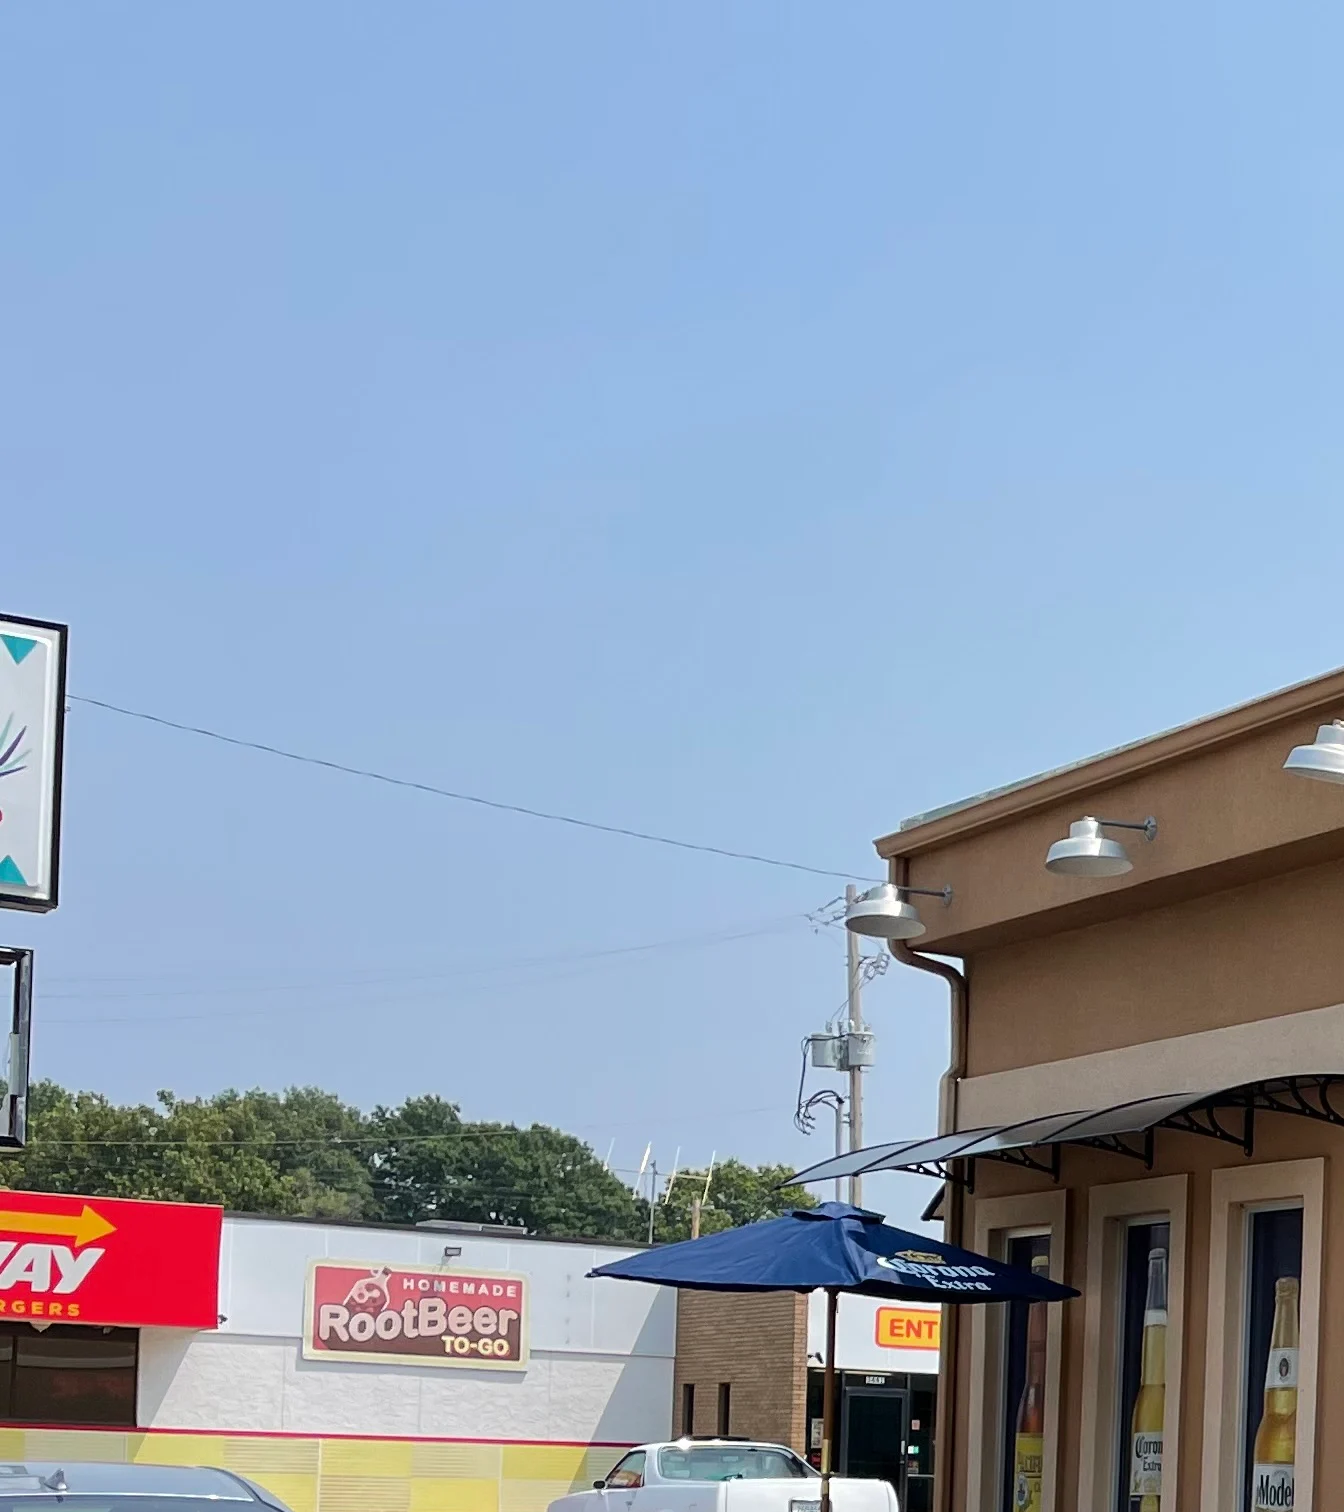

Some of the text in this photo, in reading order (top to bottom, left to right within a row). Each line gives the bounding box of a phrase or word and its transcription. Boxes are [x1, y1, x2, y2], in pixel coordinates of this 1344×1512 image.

[877, 1257, 996, 1278] Corona
[403, 1278, 518, 1298] HOMEMADE
[922, 1273, 992, 1291] Extra
[319, 1297, 519, 1343] RootBeer
[889, 1318, 939, 1340] ENT
[441, 1335, 510, 1357] TO-GO
[1135, 1436, 1163, 1458] Coron
[1257, 1474, 1295, 1508] Model
